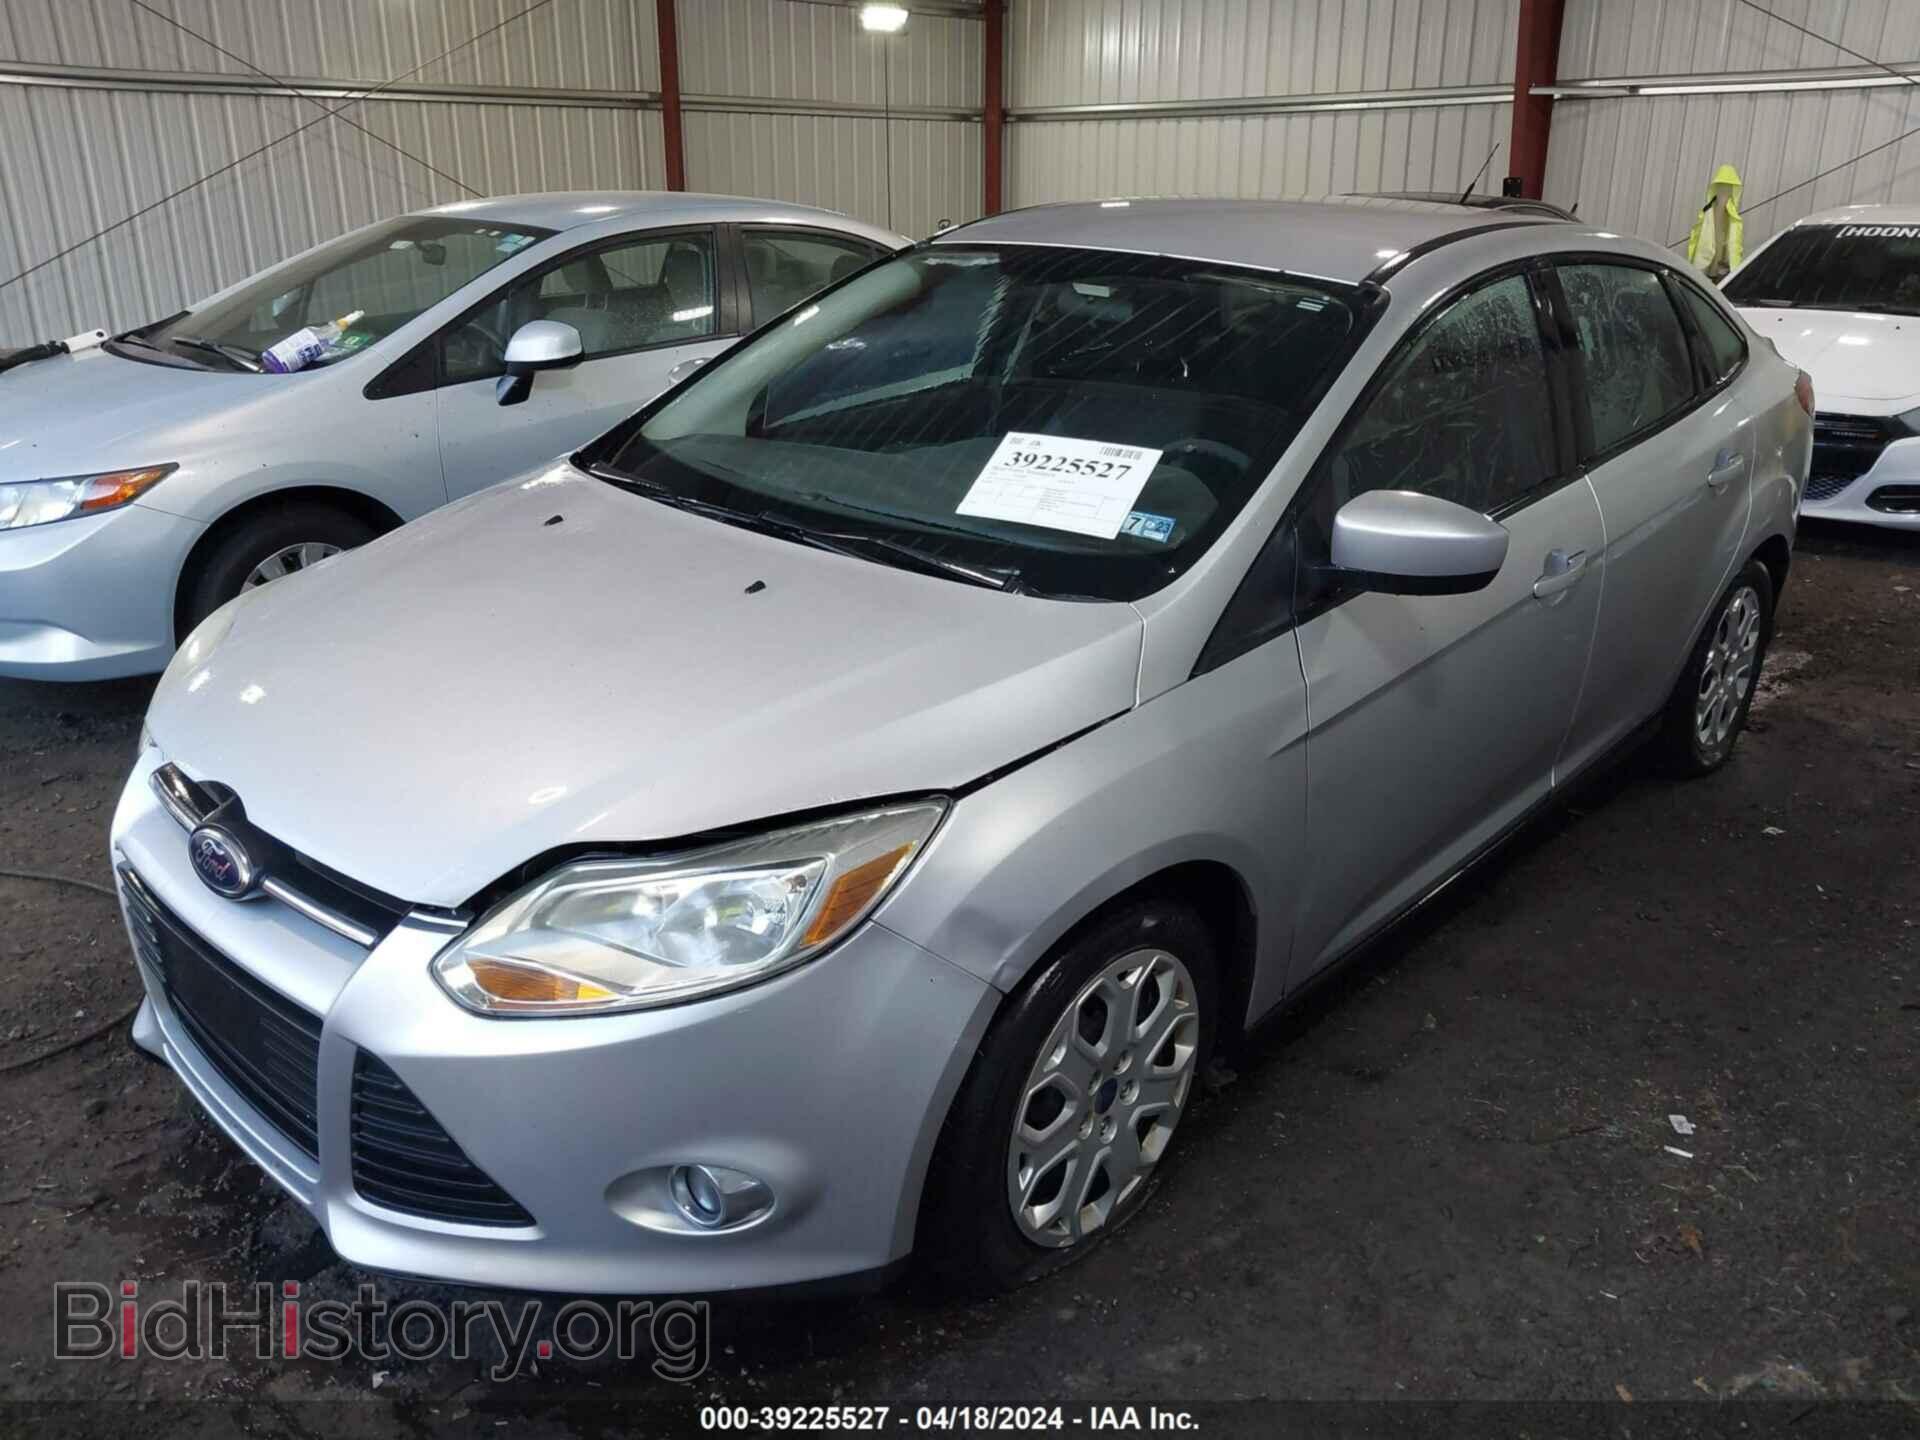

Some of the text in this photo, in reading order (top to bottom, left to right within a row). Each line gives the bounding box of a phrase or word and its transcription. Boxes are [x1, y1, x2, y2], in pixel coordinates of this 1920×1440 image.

[1005, 451, 1131, 480] 39225527
[1129, 516, 1142, 530] 7
[195, 839, 230, 880] Ford
